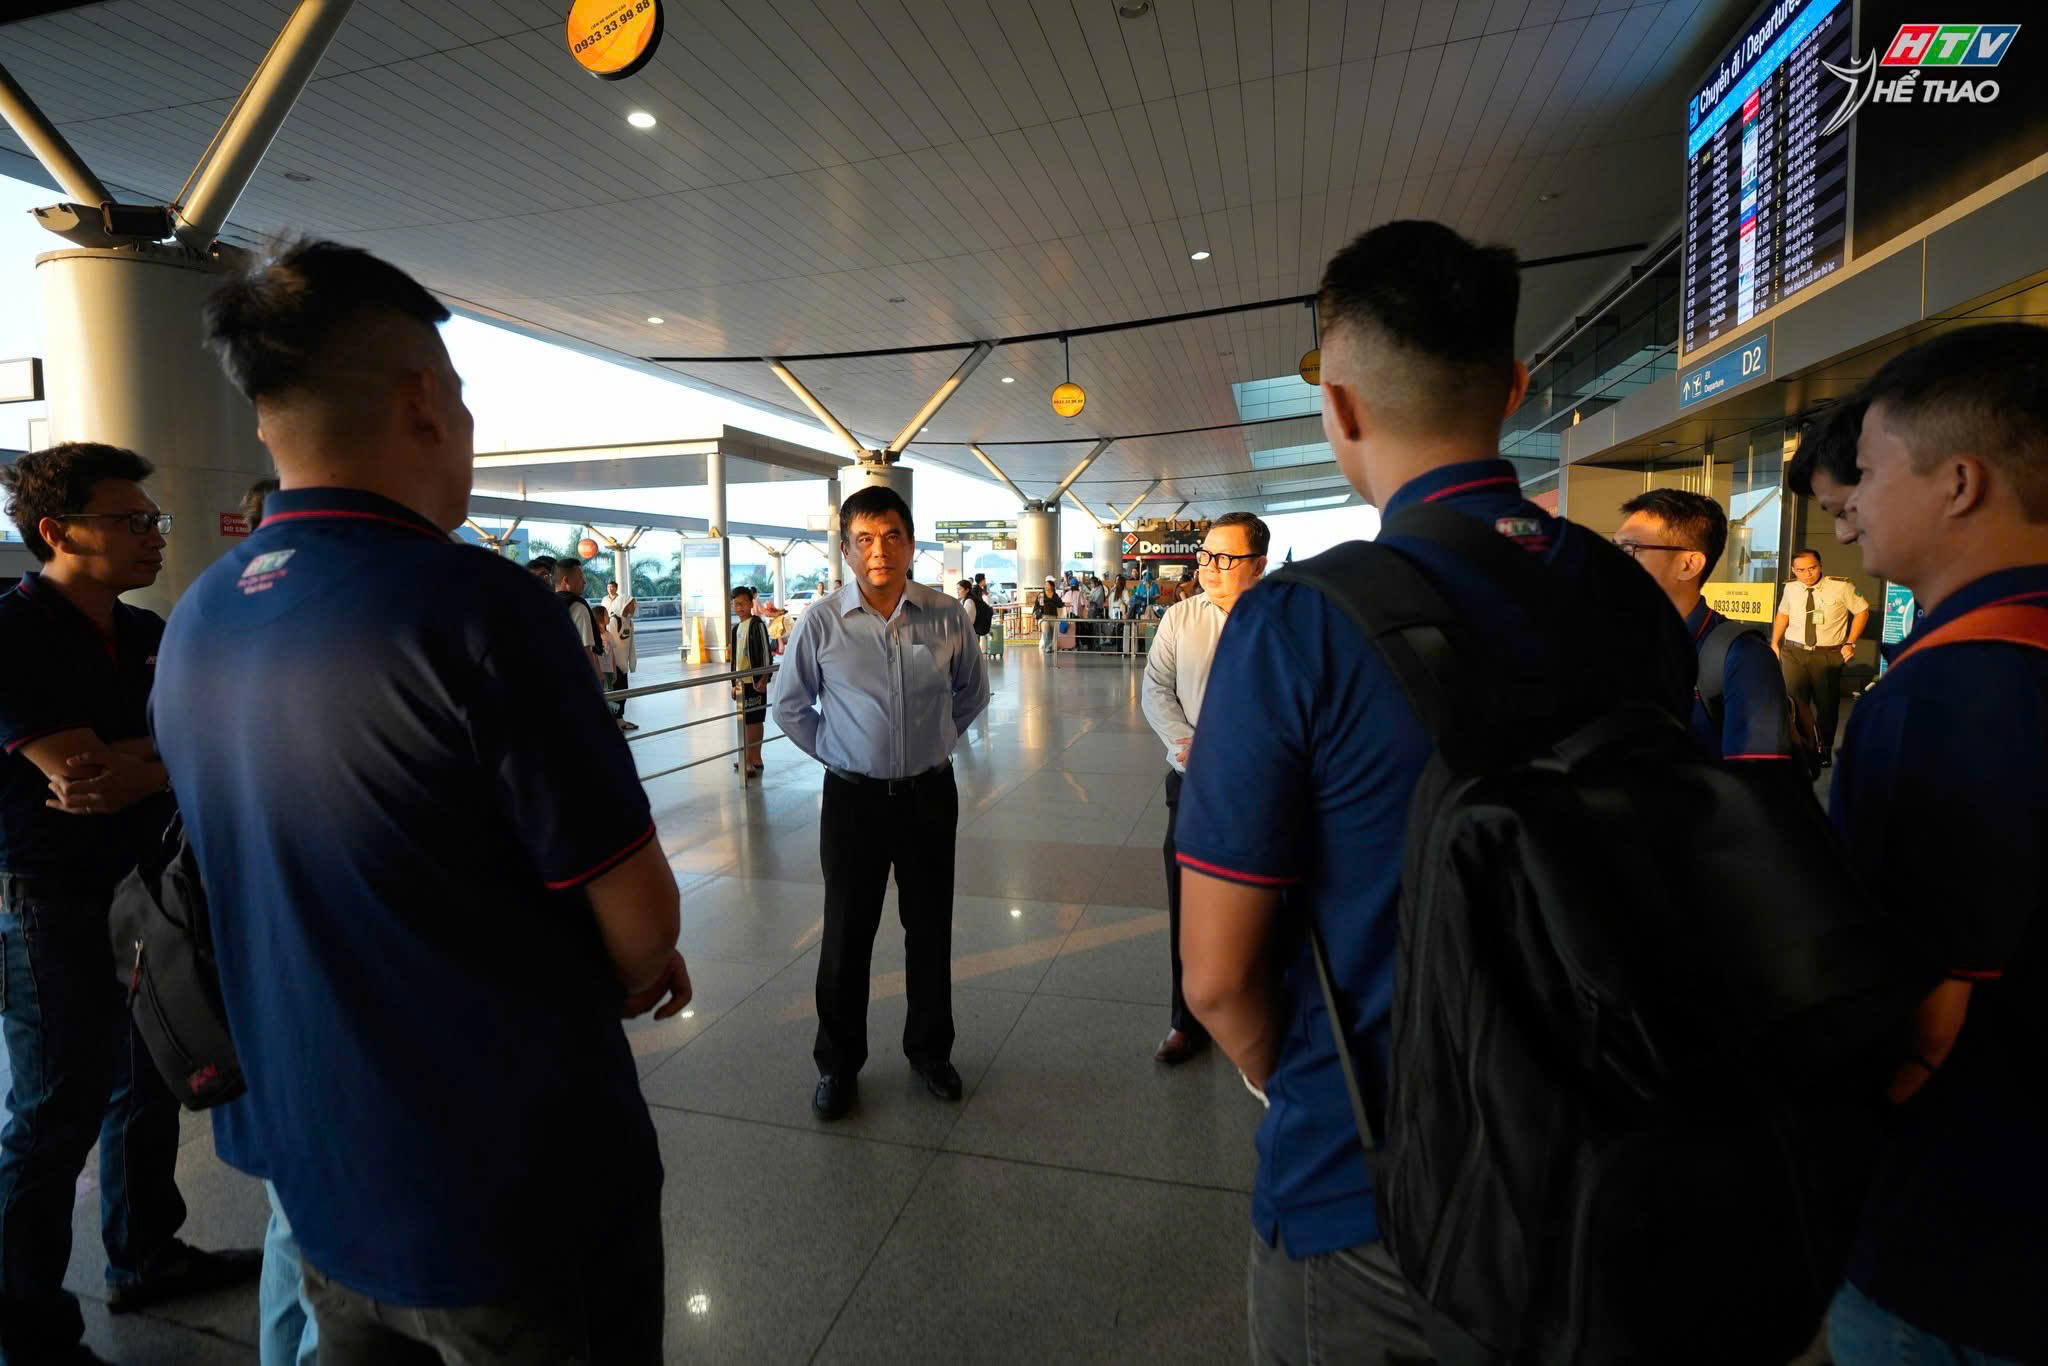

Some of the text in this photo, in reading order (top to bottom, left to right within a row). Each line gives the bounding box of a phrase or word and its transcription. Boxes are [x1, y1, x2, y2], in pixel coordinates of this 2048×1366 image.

[574, 0, 650, 54] 0933.33.99.88
[1743, 346, 1761, 376] D2
[1714, 600, 1761, 614] 0933.33.99.88
